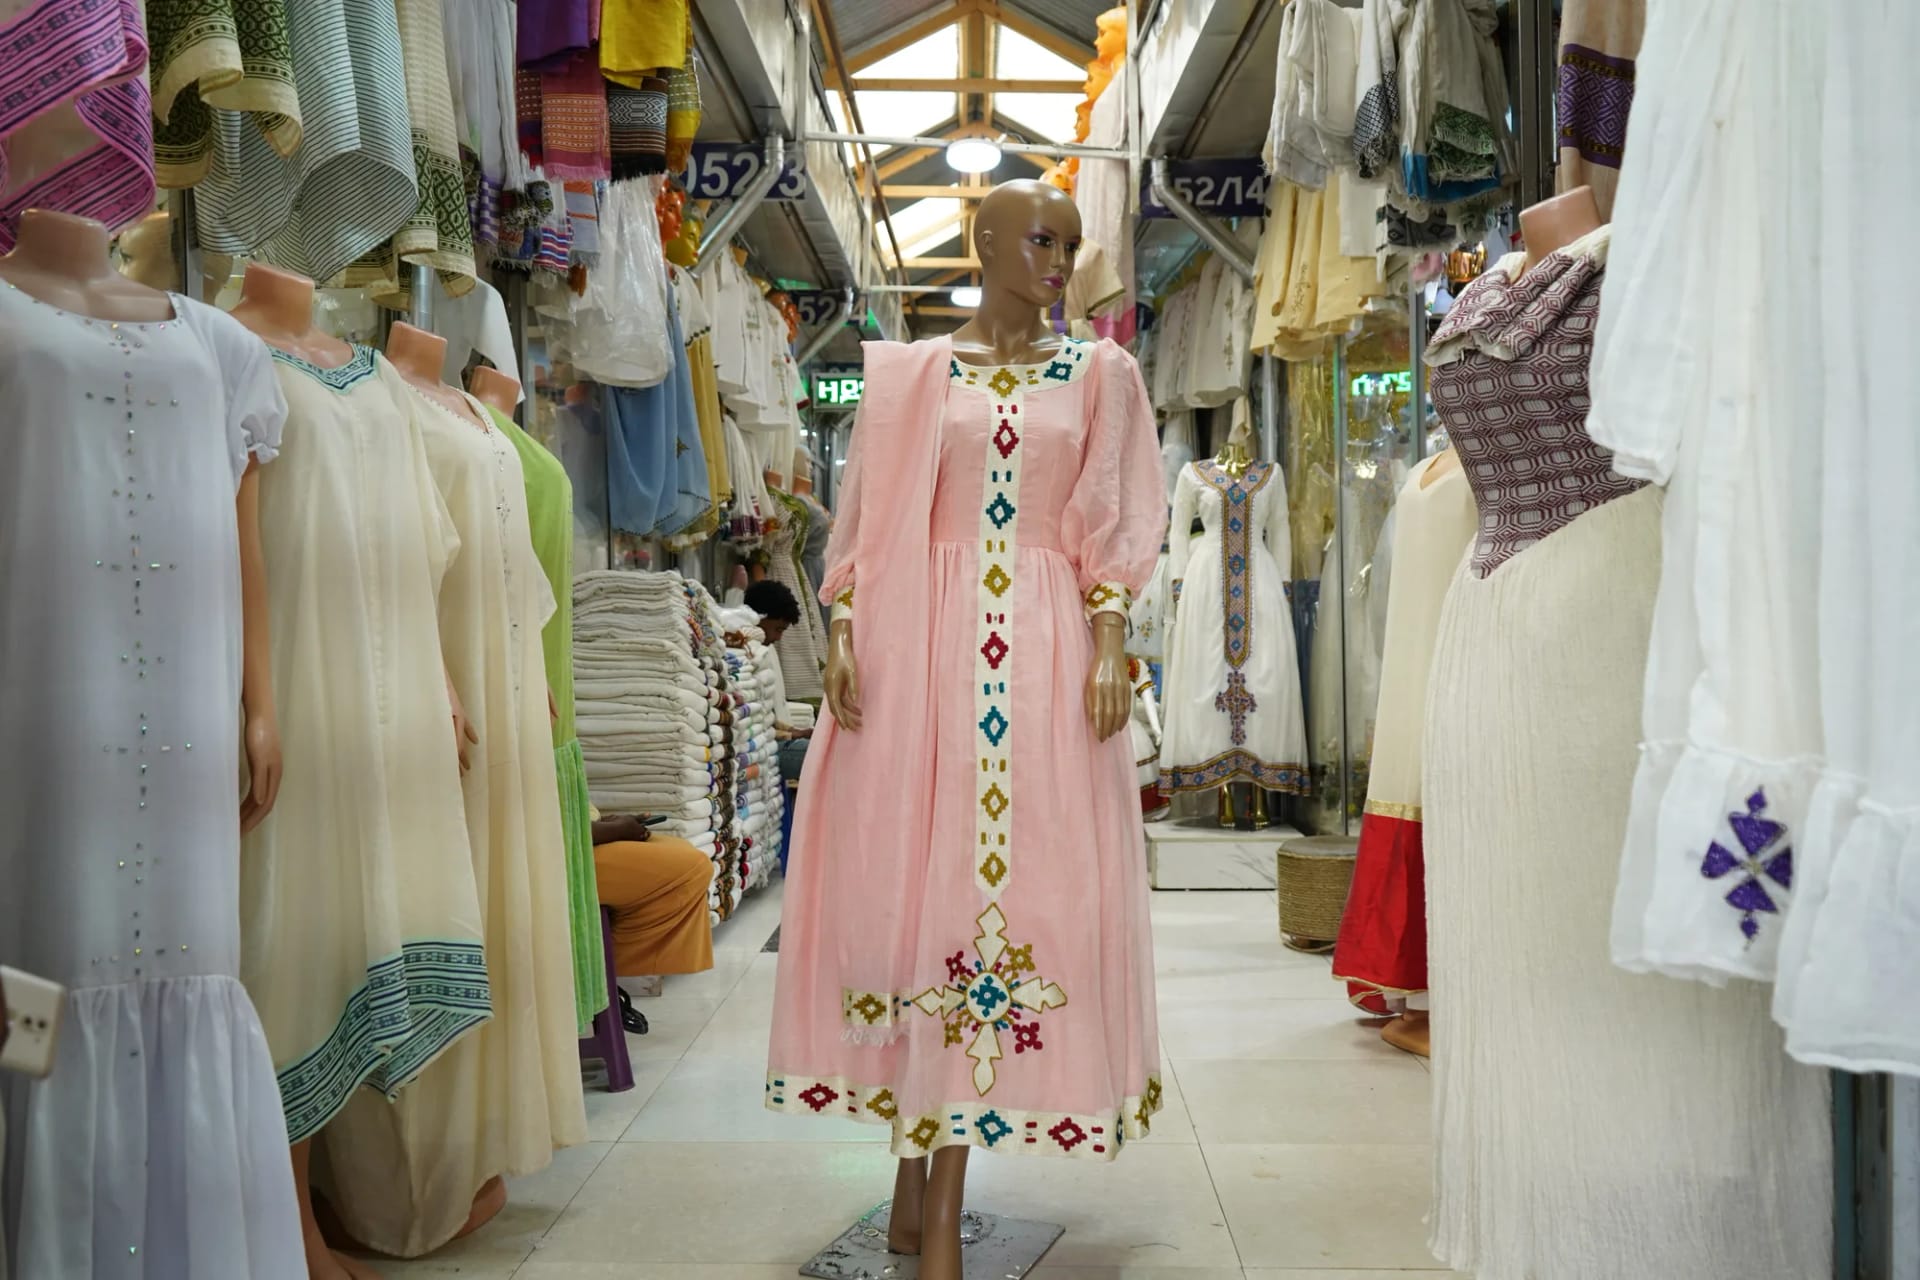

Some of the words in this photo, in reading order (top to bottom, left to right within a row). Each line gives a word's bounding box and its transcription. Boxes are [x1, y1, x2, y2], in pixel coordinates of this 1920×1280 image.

[686, 151, 806, 198] 523
[798, 295, 867, 327] 524
[818, 379, 864, 404] ዛይ
